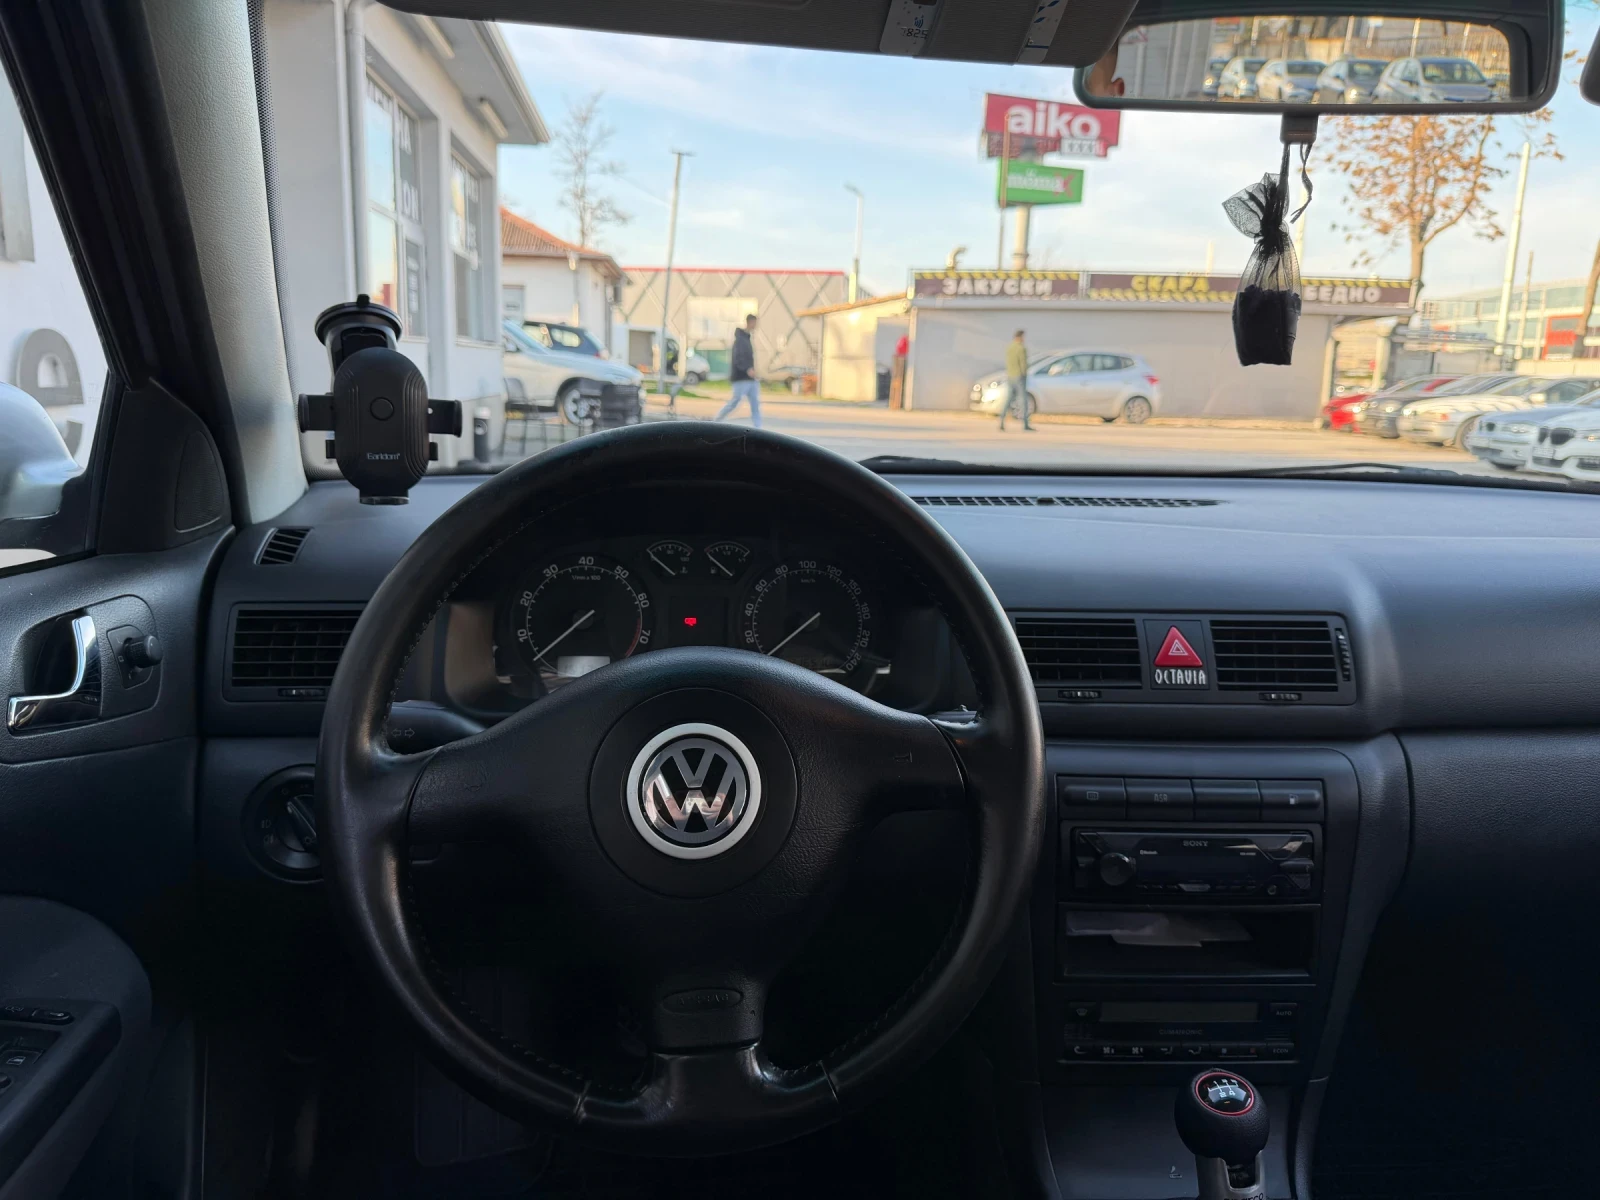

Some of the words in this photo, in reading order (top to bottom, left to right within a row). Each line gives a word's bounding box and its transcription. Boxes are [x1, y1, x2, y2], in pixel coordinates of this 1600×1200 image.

[1007, 101, 1101, 138] aiko
[942, 277, 1053, 296] ЗАКУСКИ
[1131, 275, 1210, 292] СКАРА
[1303, 285, 1381, 304] БЕДНО
[578, 556, 594, 565] 40
[798, 560, 816, 569] 100
[543, 564, 559, 578] 30
[613, 565, 630, 579] 50
[775, 564, 789, 575] 80
[826, 564, 843, 577] 120
[754, 579, 768, 593] 60
[848, 579, 863, 596] 150
[520, 590, 533, 607] 20
[637, 592, 650, 609] 60
[744, 603, 754, 617] 40
[517, 628, 529, 643] 10
[639, 629, 651, 645] 70
[744, 630, 755, 644] 20
[845, 652, 862, 671] 240
[1154, 669, 1206, 685] OCTAVIA
